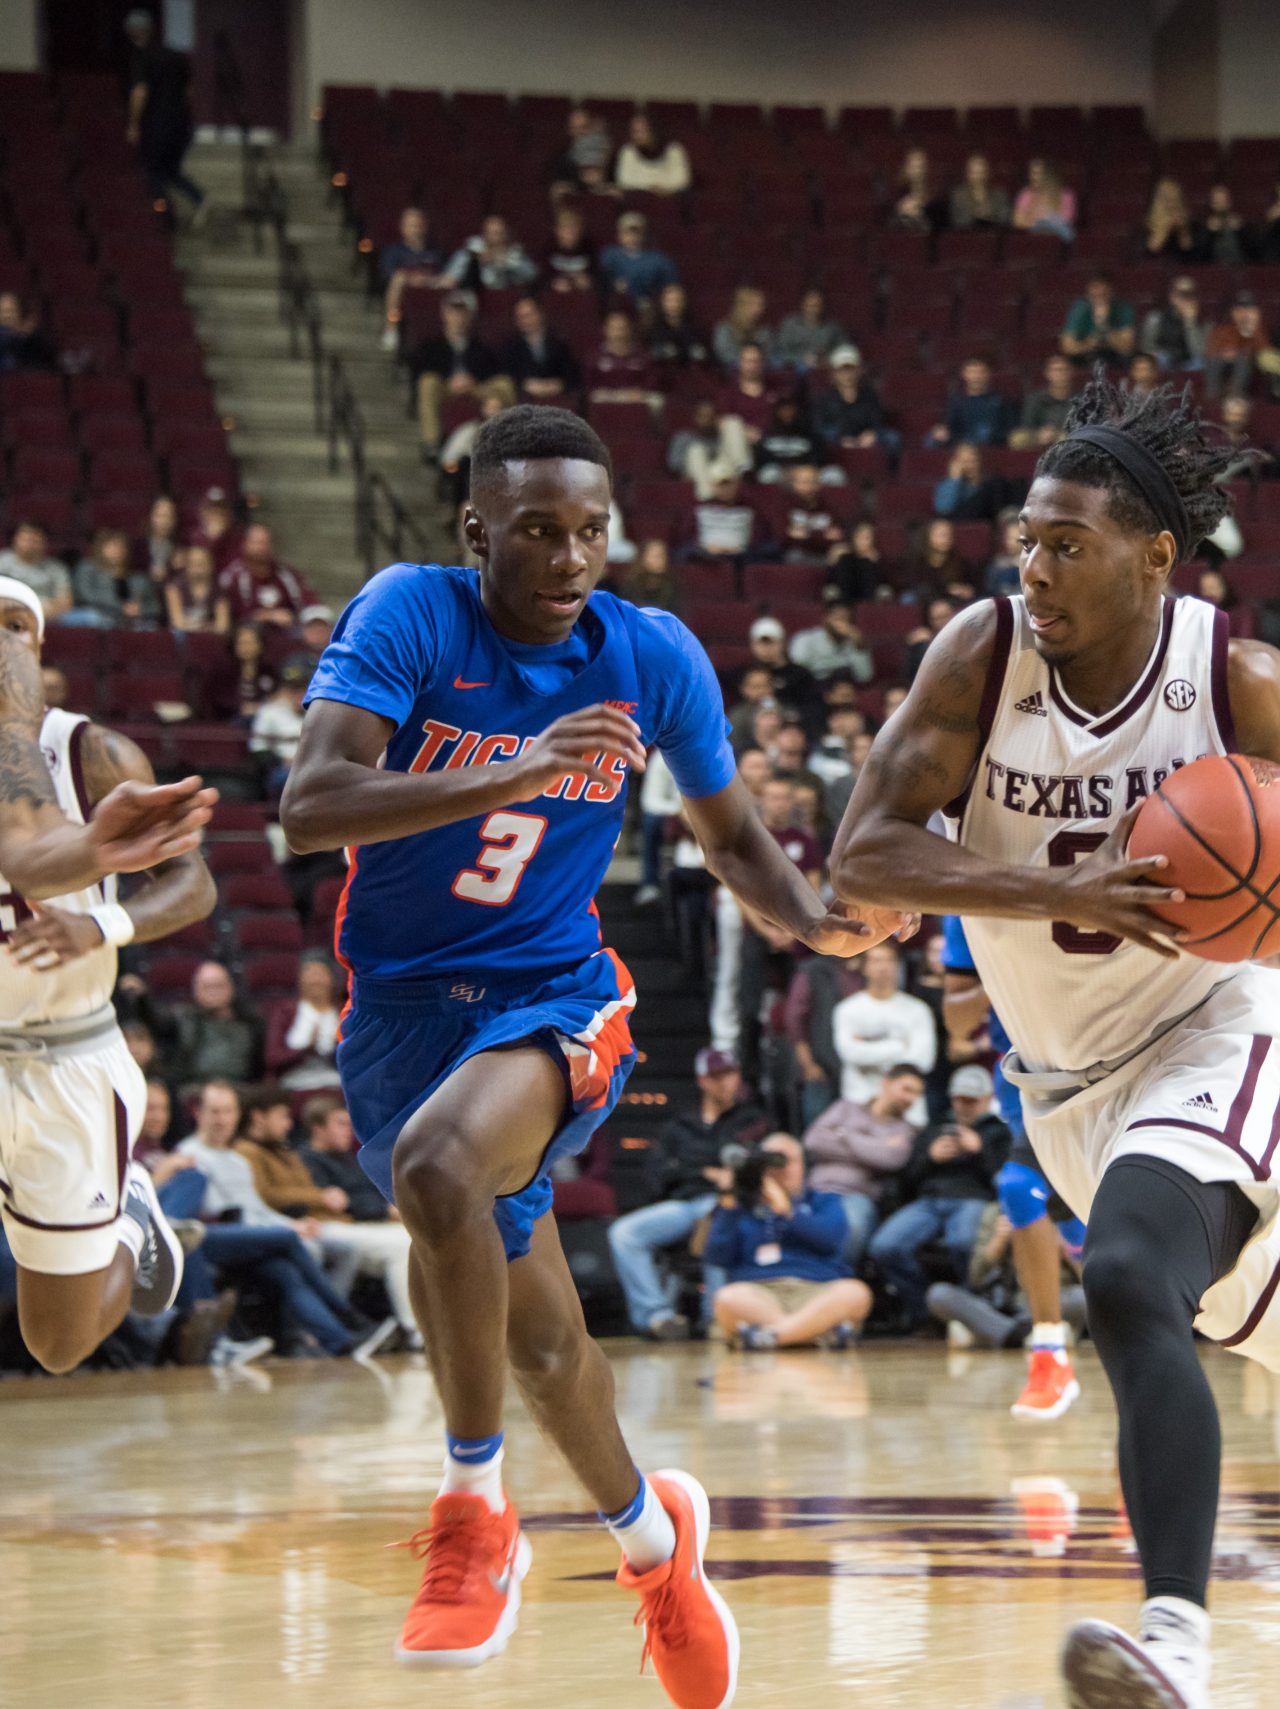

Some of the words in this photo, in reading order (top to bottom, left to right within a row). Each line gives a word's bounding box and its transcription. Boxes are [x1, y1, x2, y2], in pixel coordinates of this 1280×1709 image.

[1014, 702, 1048, 718] adidas
[985, 755, 1113, 819] TEXAS
[451, 809, 548, 907] 3
